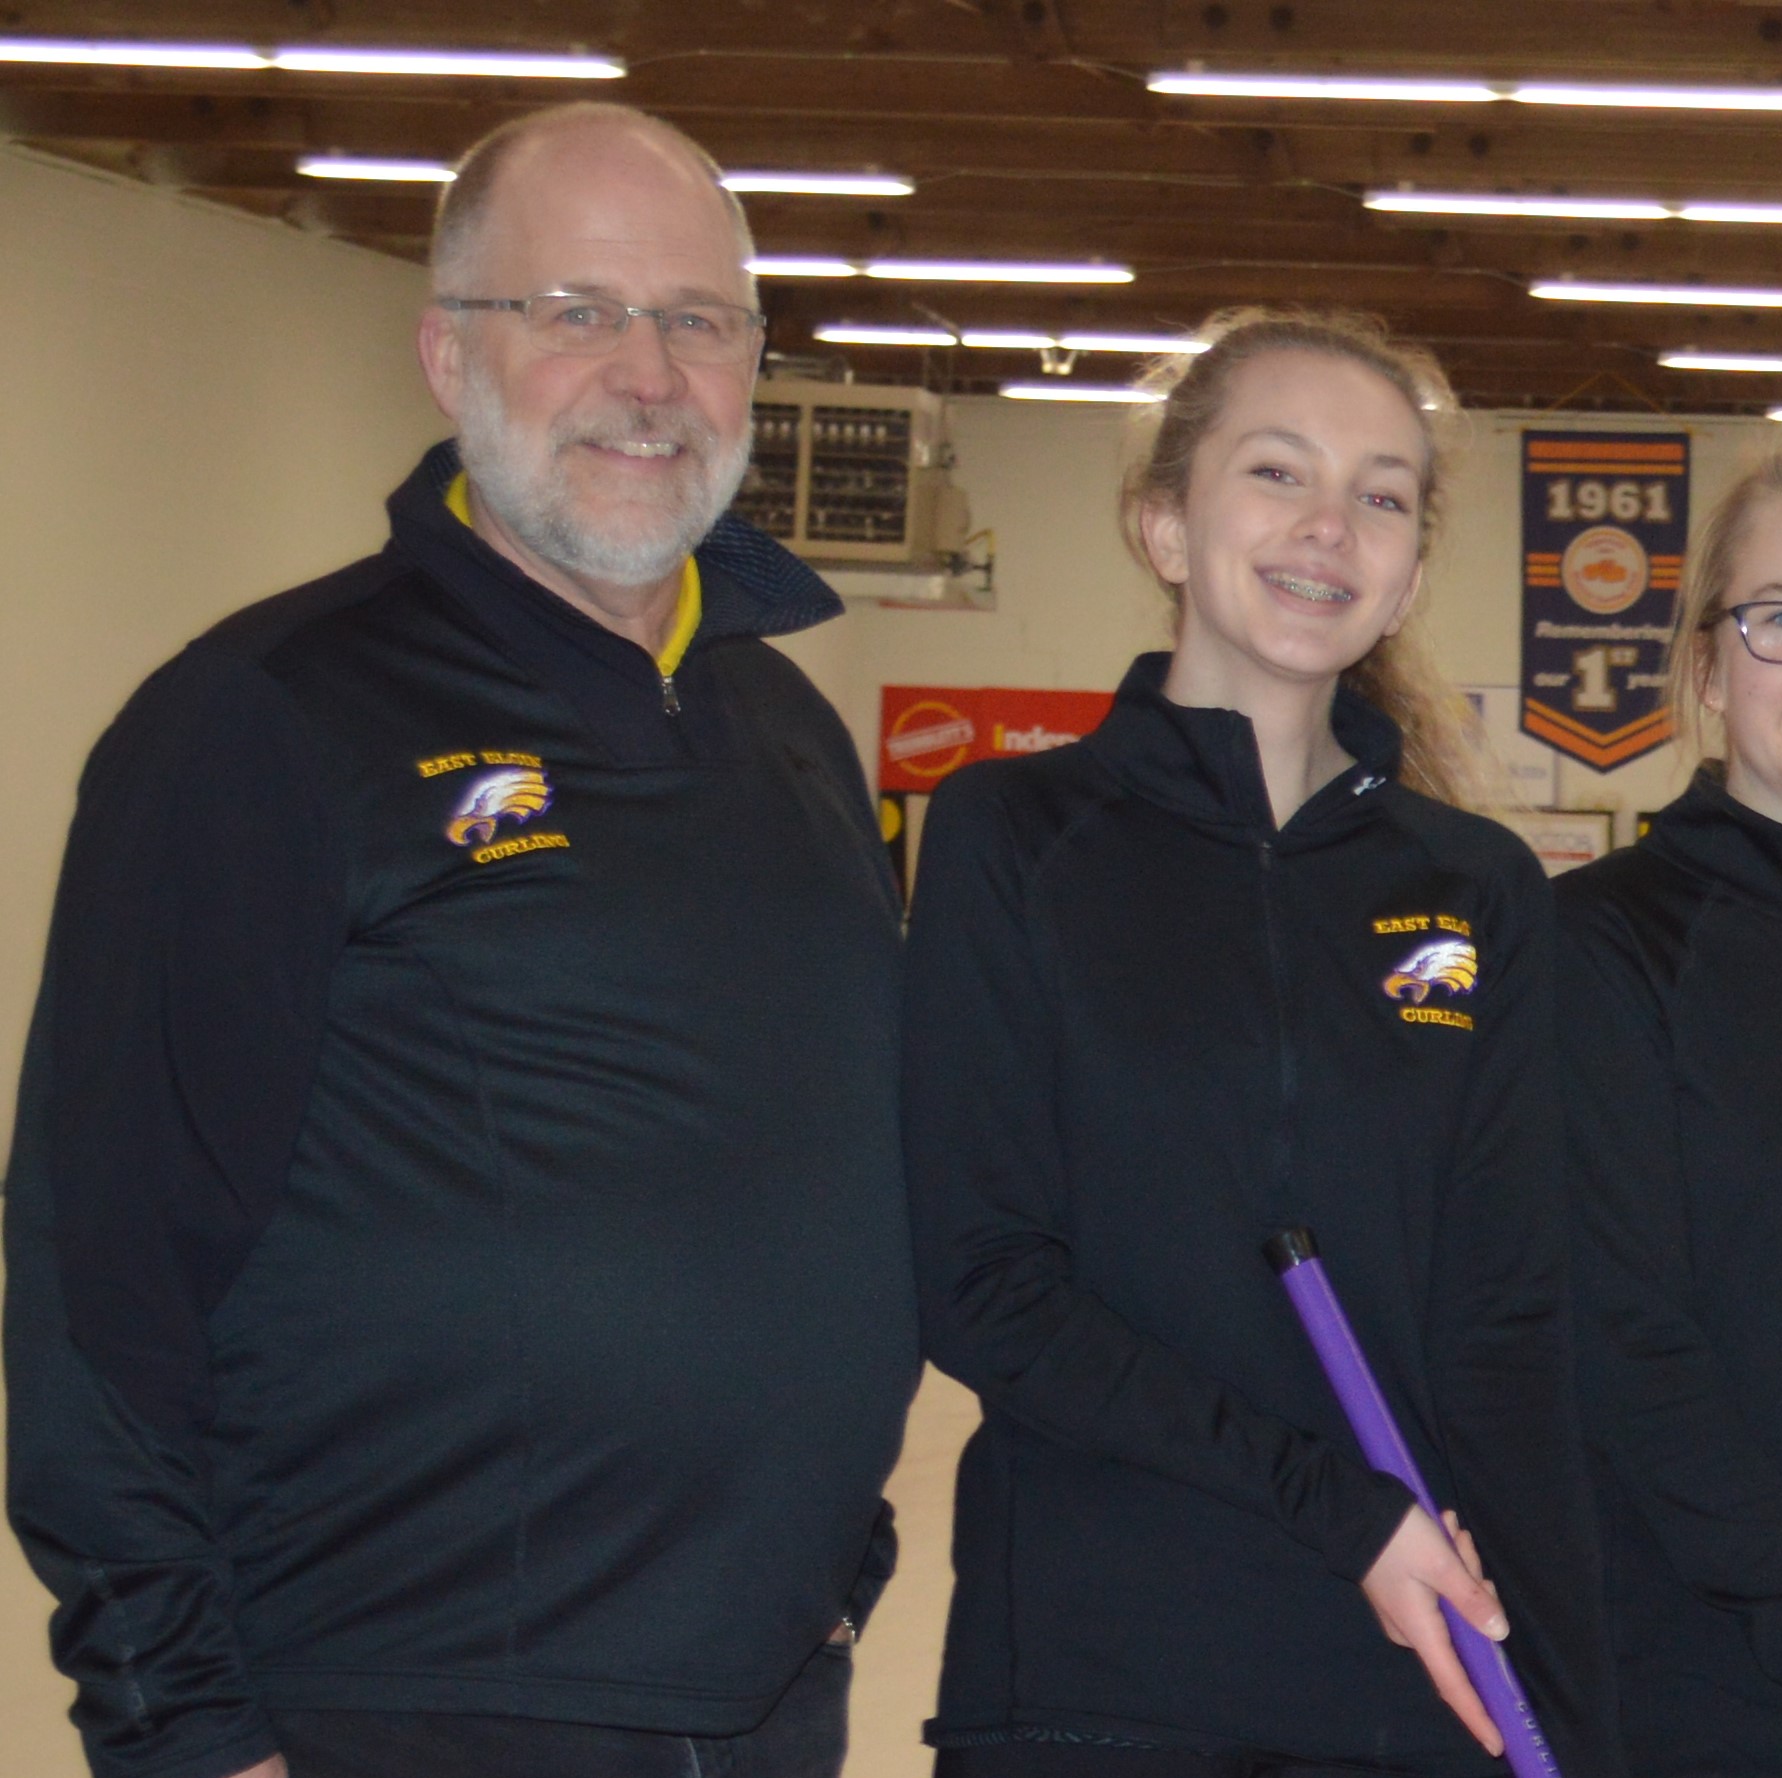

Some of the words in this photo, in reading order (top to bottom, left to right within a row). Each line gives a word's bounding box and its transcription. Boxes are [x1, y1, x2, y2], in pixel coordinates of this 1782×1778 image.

[1547, 479, 1671, 521] 1961
[417, 752, 477, 778] EAST
[480, 750, 544, 769] ELGIN
[472, 832, 570, 863] CURLING
[1372, 915, 1430, 934] EAST
